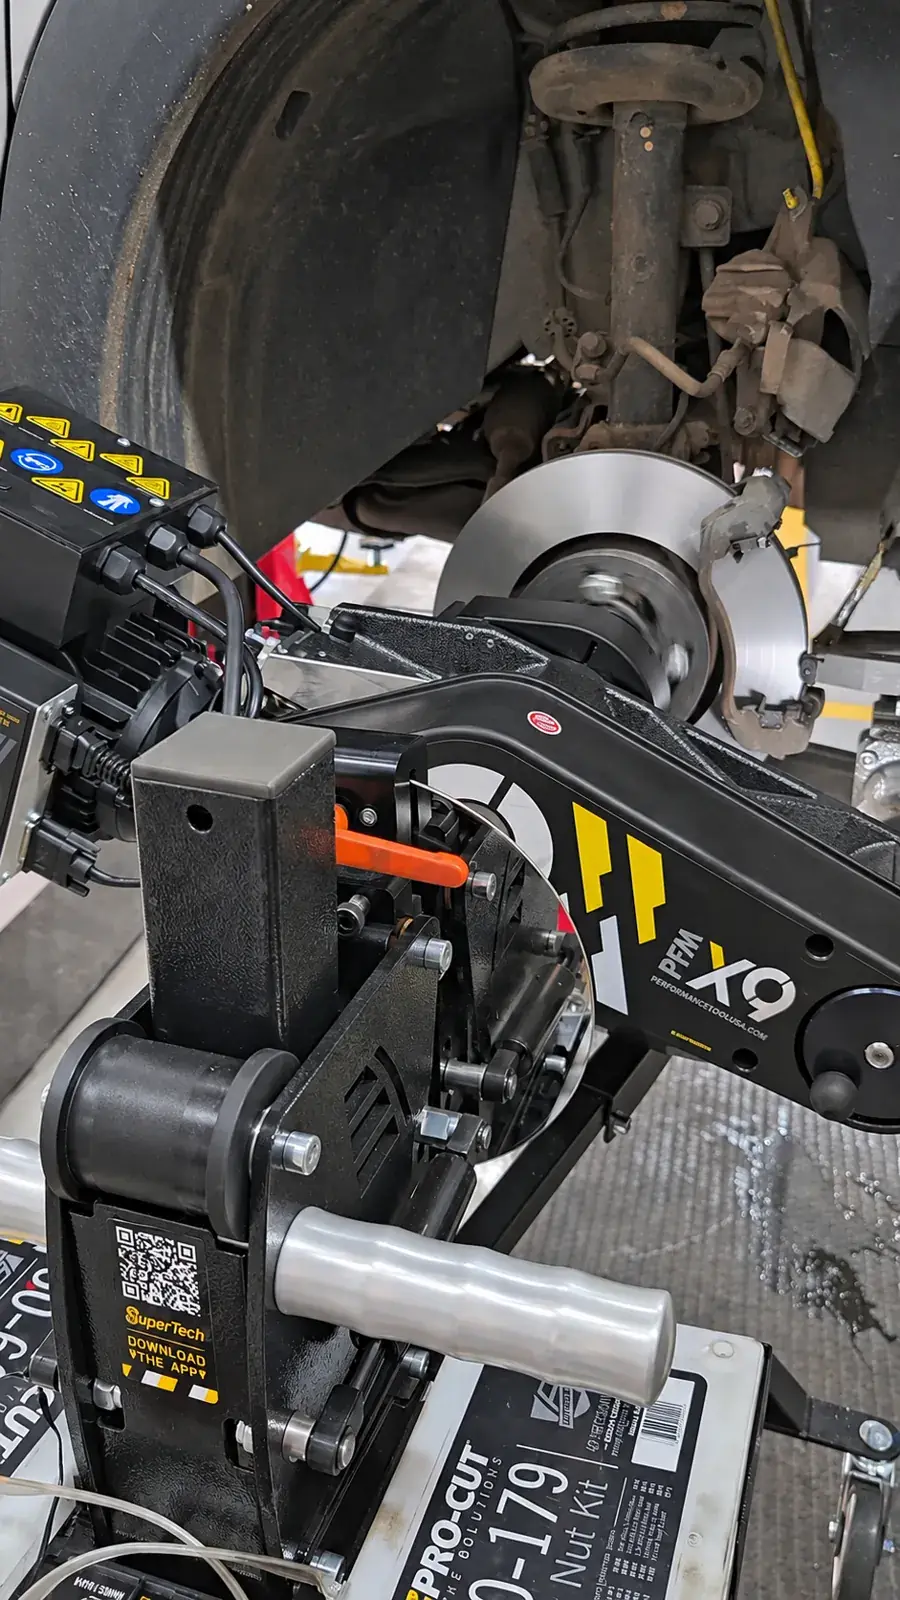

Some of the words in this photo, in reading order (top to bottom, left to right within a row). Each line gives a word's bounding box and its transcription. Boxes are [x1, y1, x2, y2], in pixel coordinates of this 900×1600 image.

[657, 928, 704, 981] PFM
[685, 940, 797, 1022] X9
[650, 975, 769, 1042] PERFORMANCETOOLUSA.COM
[125, 1305, 205, 1342] SuperTech
[128, 1335, 206, 1367] DOWNLOAD
[136, 1351, 164, 1369] THE
[170, 1361, 198, 1377] APP
[411, 1443, 489, 1600] PRO-CUT
[569, 1479, 609, 1519] Kit
[549, 1526, 596, 1588] Nut
